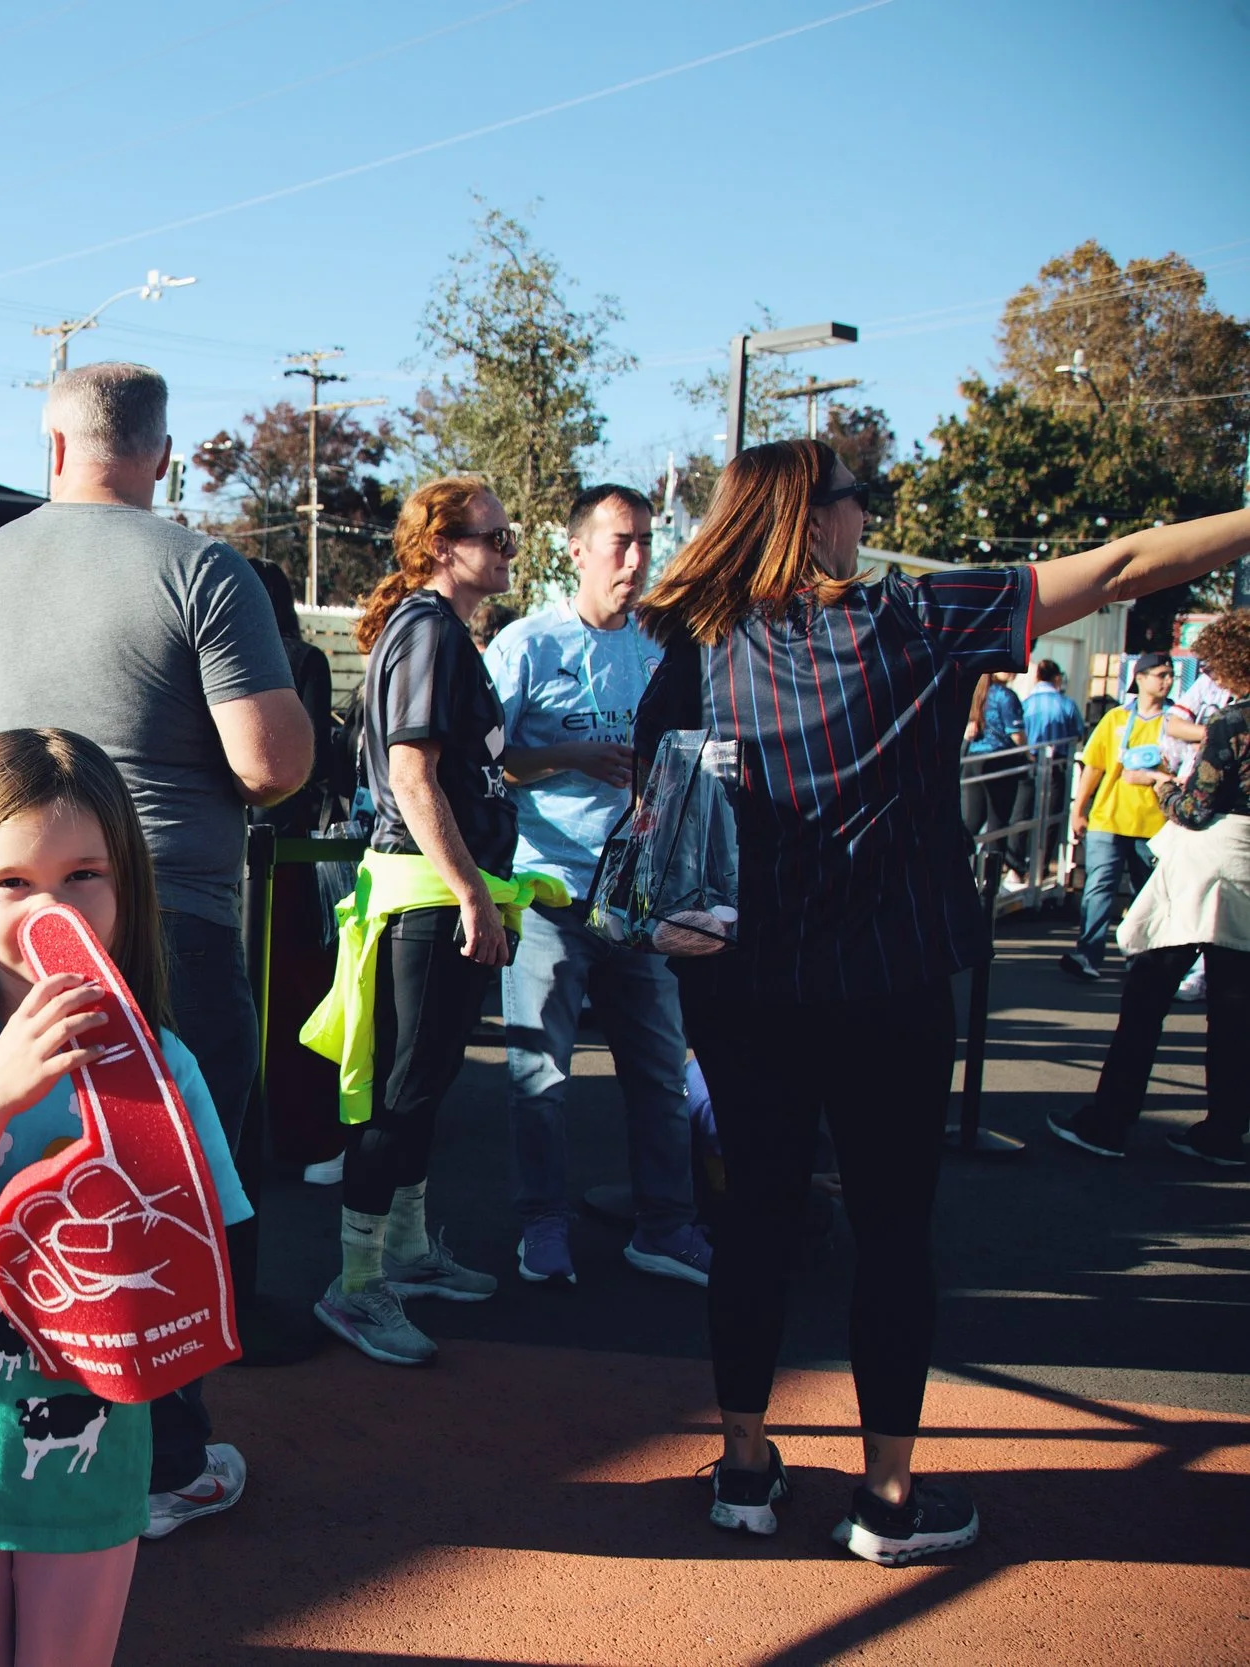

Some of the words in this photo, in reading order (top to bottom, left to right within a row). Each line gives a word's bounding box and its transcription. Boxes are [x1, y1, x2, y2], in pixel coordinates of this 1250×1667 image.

[39, 1328, 89, 1347] TAKE
[90, 1333, 139, 1349] THE
[144, 1308, 210, 1343] SHOT!
[61, 1351, 124, 1376] Canon
[151, 1339, 204, 1369] NWSL
